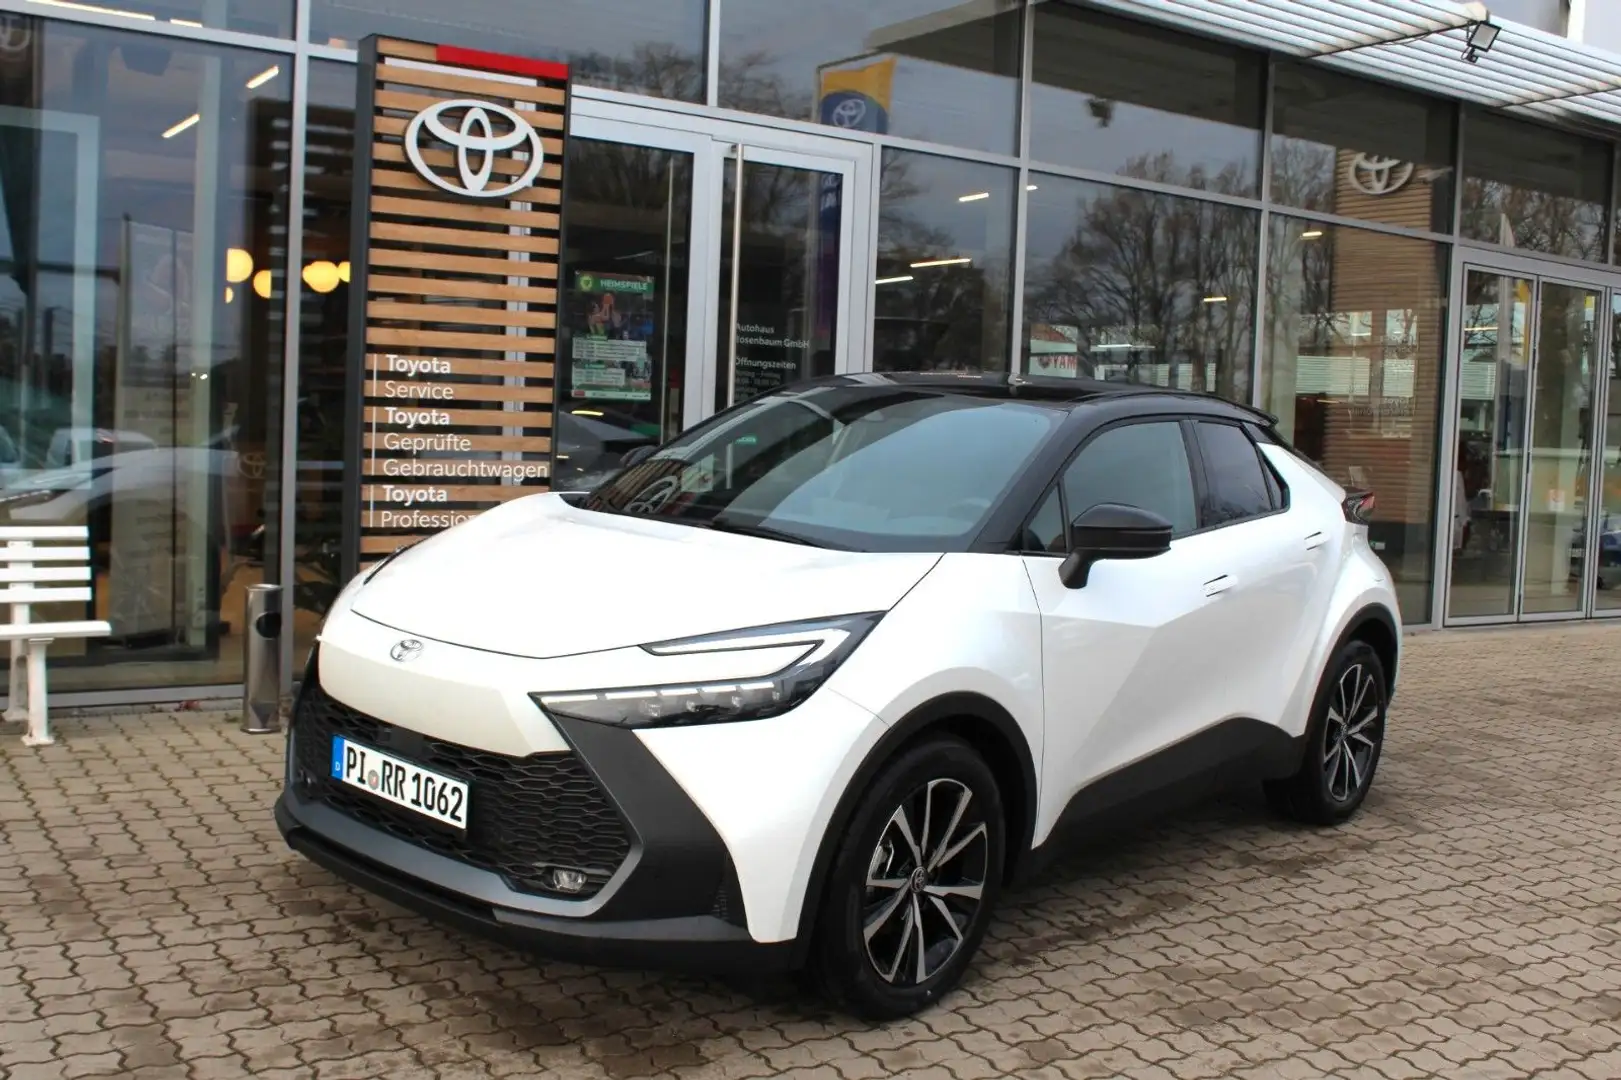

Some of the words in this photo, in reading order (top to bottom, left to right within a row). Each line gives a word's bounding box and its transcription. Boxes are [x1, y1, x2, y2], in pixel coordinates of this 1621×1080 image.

[783, 338, 810, 349] GmbH
[385, 354, 451, 377] Toyota
[384, 380, 454, 400] Service
[384, 406, 450, 429] Toyota
[383, 432, 472, 454] Geprüfte
[382, 459, 548, 482] Gebrauchtwagen
[382, 485, 448, 507] Toyota
[346, 746, 366, 785] PI
[382, 759, 405, 801] RR
[410, 772, 463, 822] 1062
